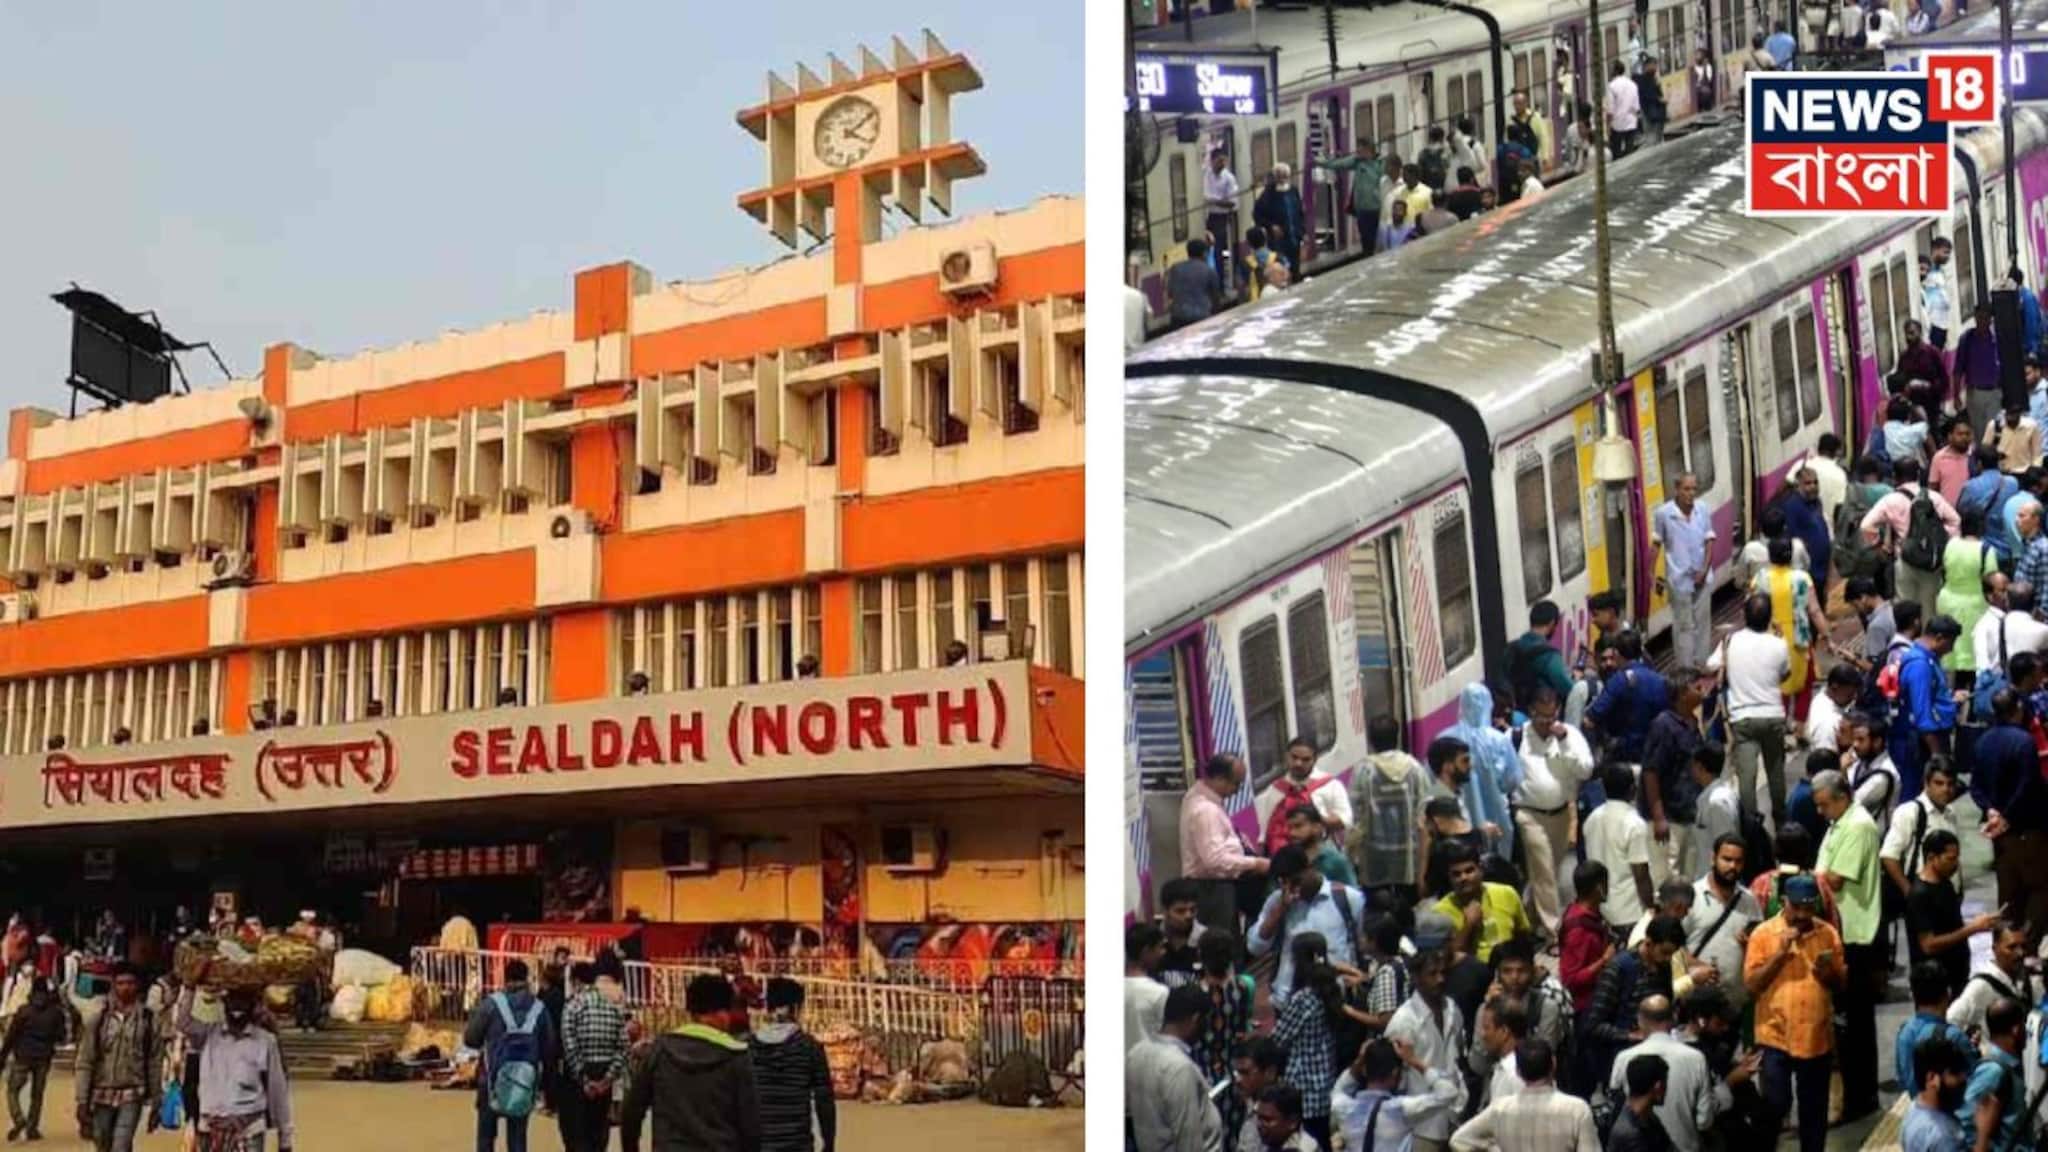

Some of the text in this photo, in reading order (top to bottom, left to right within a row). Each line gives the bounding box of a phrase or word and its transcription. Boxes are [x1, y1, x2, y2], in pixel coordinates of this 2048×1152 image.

[41, 730, 394, 808] सियालदह (उत्तर)
[451, 678, 1006, 779] SEALDAH (NORTH)
